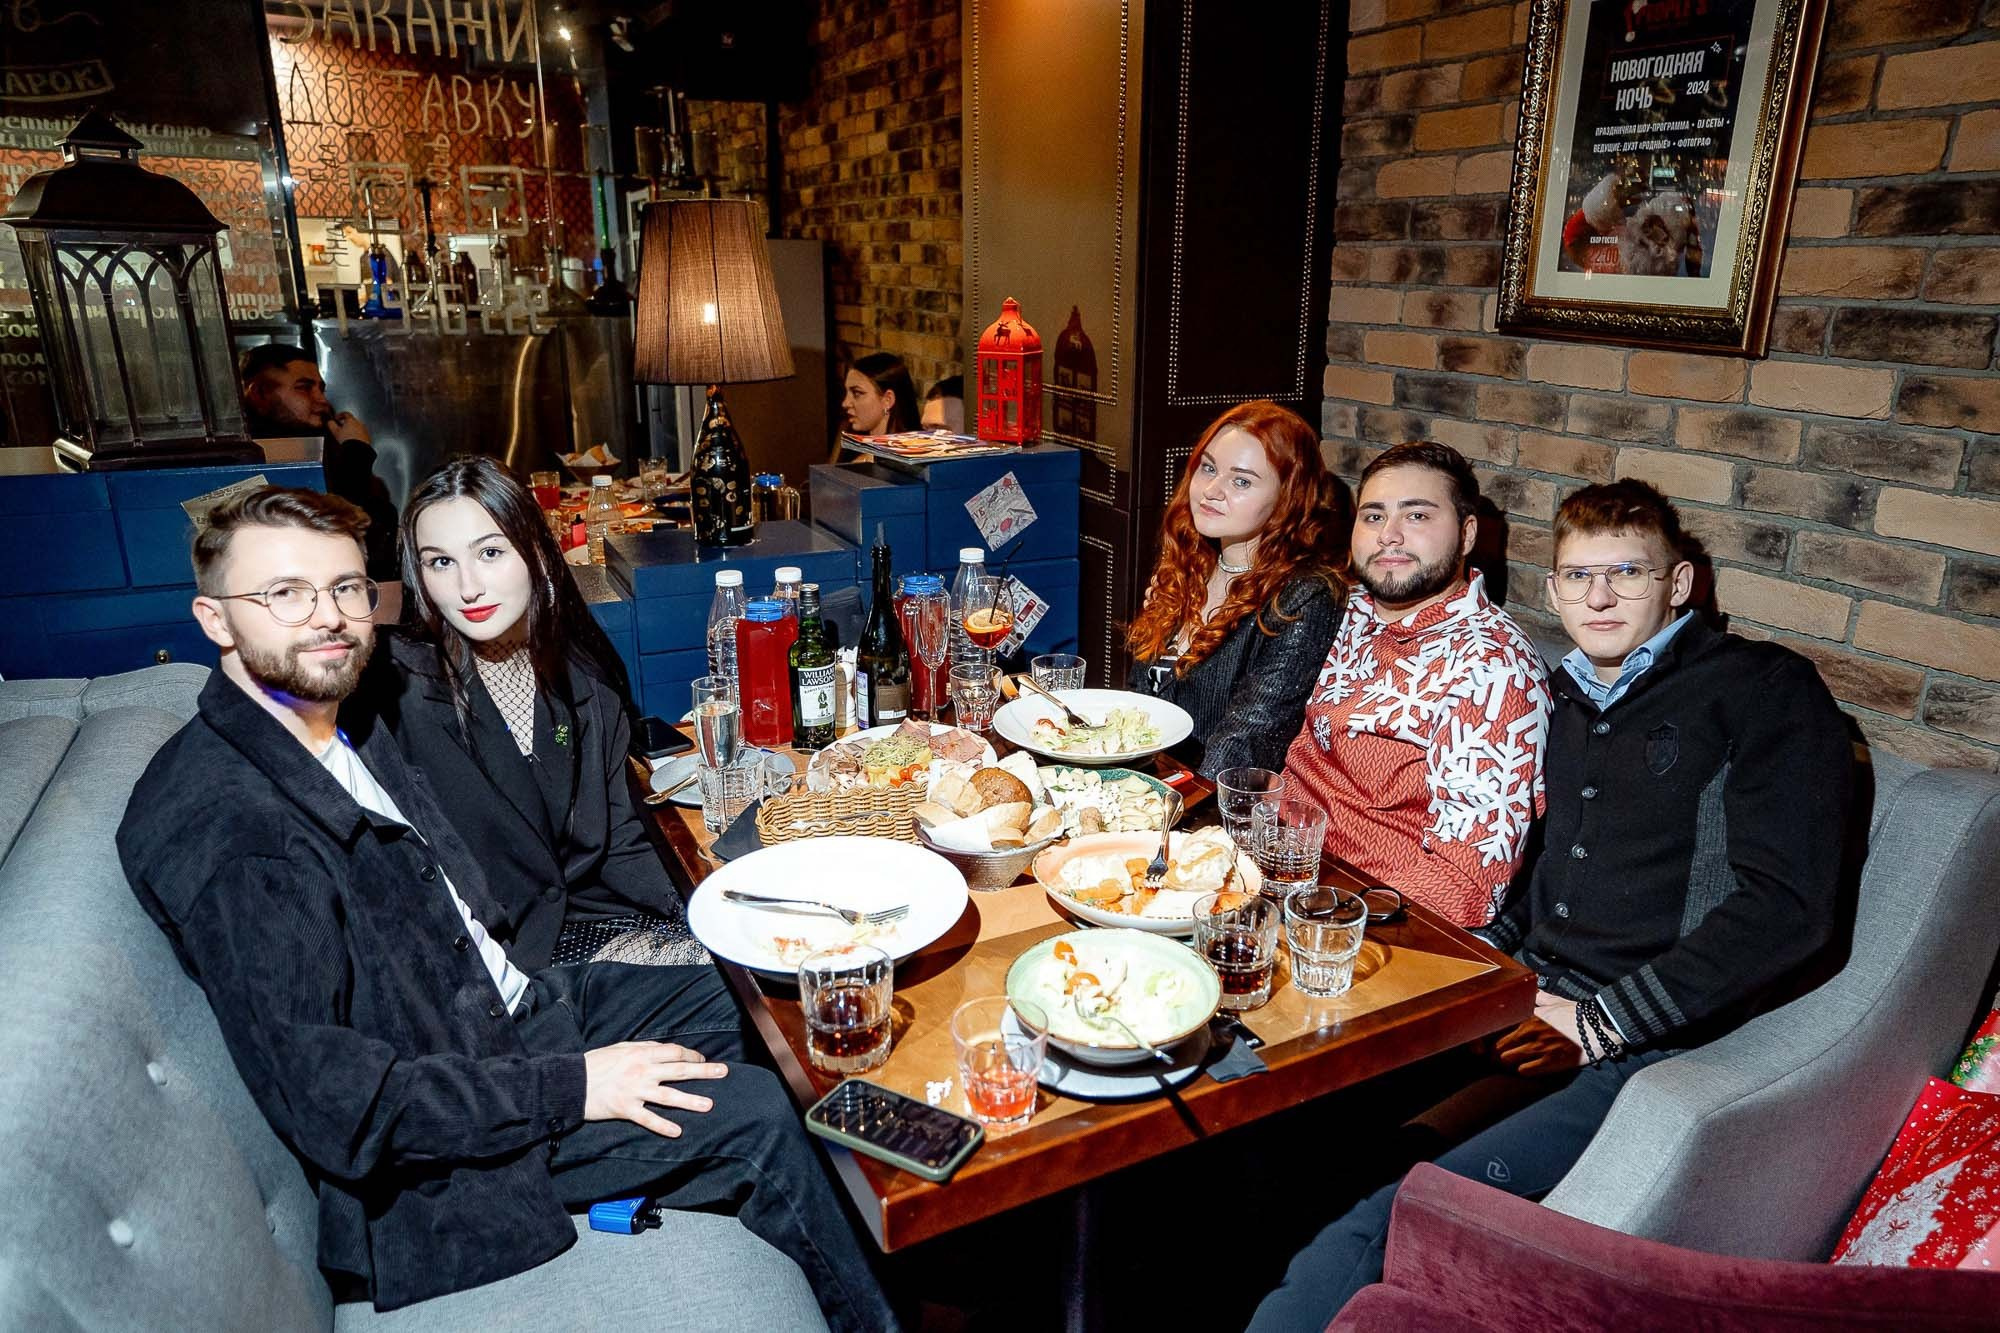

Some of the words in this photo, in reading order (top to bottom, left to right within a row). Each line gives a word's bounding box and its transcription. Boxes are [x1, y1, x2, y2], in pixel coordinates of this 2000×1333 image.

[1610, 50, 1705, 83] НОВОГОДНЯЯ
[286, 62, 536, 139] ДОСТАВКУ
[1615, 86, 1653, 111] НОЧЬ
[1686, 80, 1710, 95] 2024
